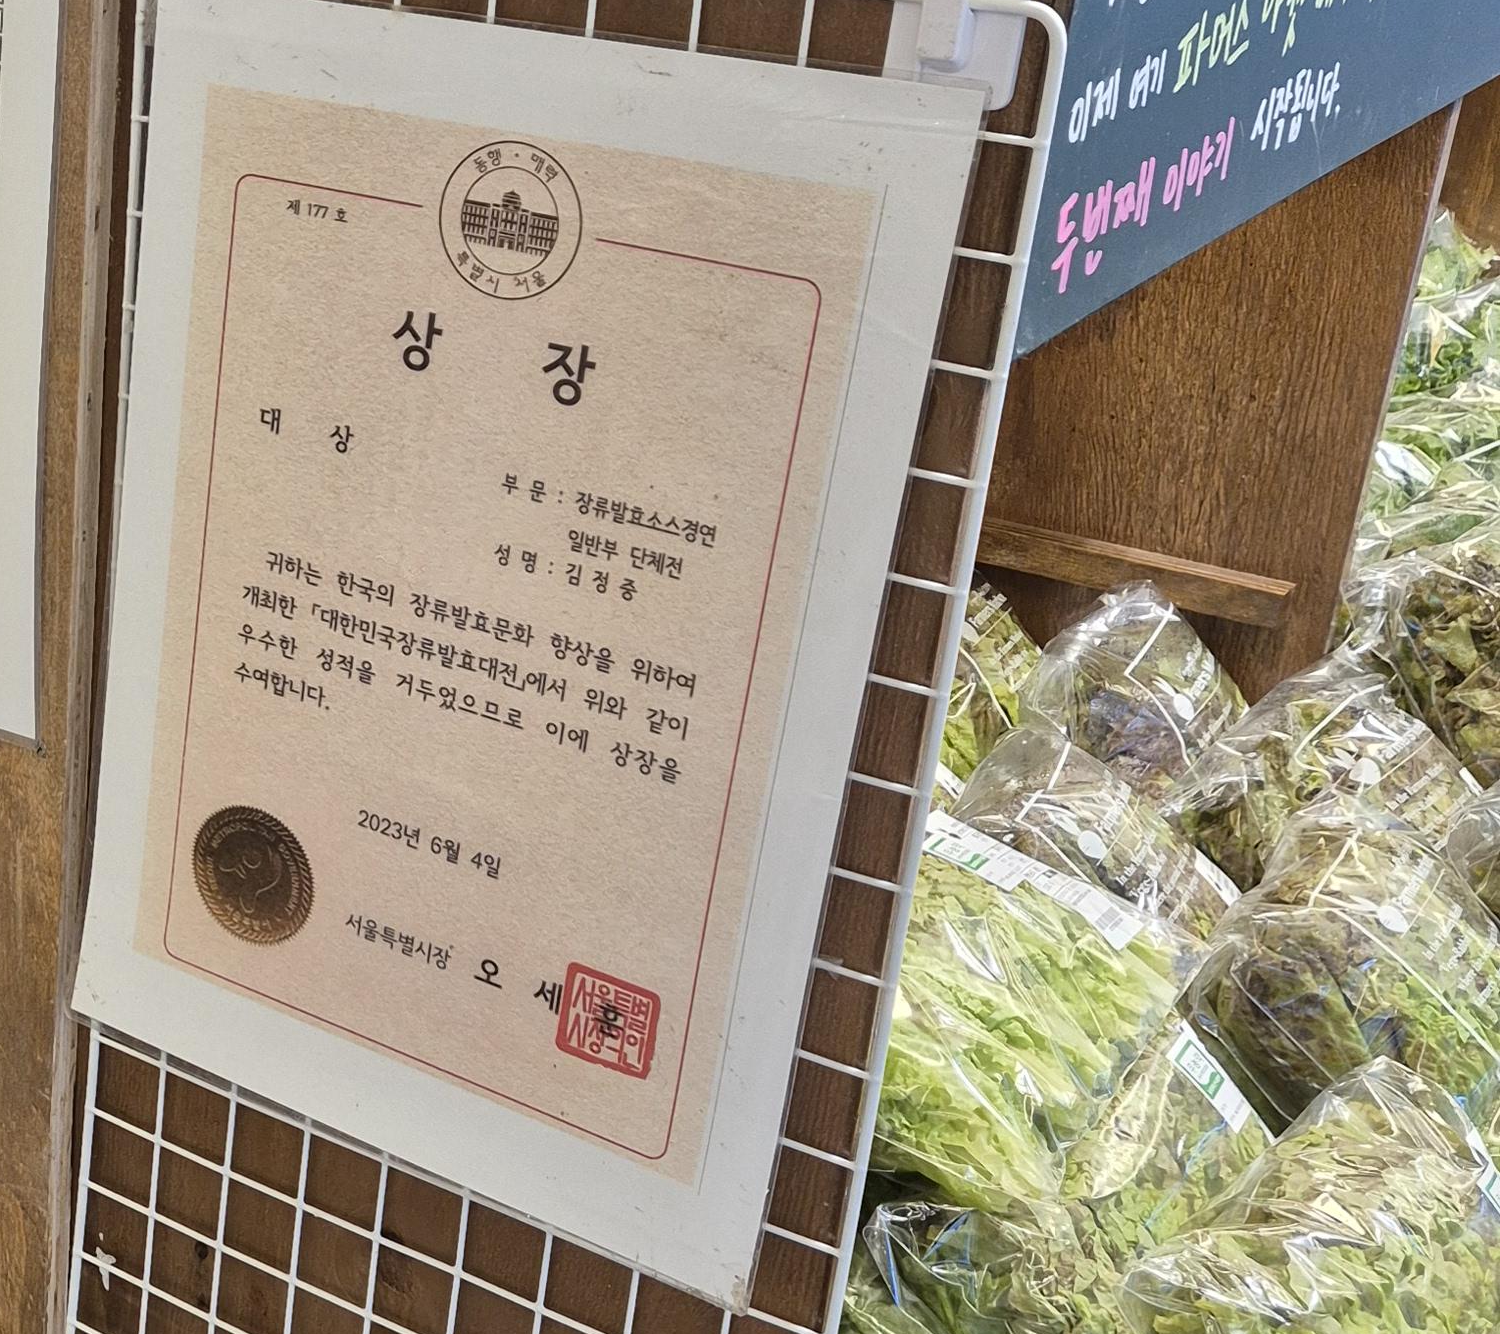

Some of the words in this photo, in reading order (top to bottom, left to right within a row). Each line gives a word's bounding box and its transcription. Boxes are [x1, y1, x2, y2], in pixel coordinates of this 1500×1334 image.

[1068, 70, 1120, 144] 이제
[1128, 49, 1168, 110] 여기
[285, 197, 302, 217] 제
[304, 200, 331, 221] 177
[332, 205, 349, 225] 호
[1051, 156, 1156, 293] 두번째
[1162, 116, 1236, 211] 이야기
[390, 308, 444, 375] 상
[539, 339, 598, 409] 장
[258, 405, 284, 435] 대
[328, 422, 356, 456] 상
[501, 473, 519, 495] 부
[529, 480, 547, 503] 문
[575, 492, 717, 548] 장류발효소스경연
[494, 544, 511, 566] 성
[521, 551, 537, 573] 명
[565, 563, 582, 586] 김
[568, 530, 619, 561] 일반부
[630, 546, 684, 580] 단체전
[242, 585, 298, 619] 개최한
[582, 686, 629, 721] 위와
[645, 705, 690, 741] 같이
[264, 550, 324, 588] 귀하는
[336, 569, 396, 609] 한국의
[408, 589, 536, 651] 장류발효문화
[549, 629, 614, 675] 향상을
[630, 652, 698, 698] 위하여
[232, 658, 332, 715] 수여합니다.
[236, 623, 299, 660] 우수한
[315, 645, 377, 685] 성적을
[394, 669, 526, 733] 거두었으므로
[544, 719, 592, 754] 이에
[609, 738, 684, 786] 상장을
[356, 806, 422, 851] 2023년
[429, 829, 461, 863] 6월
[469, 847, 504, 881] 4일
[346, 912, 452, 970] 서울특별시장
[474, 957, 503, 989] 오
[533, 977, 563, 1015] 세
